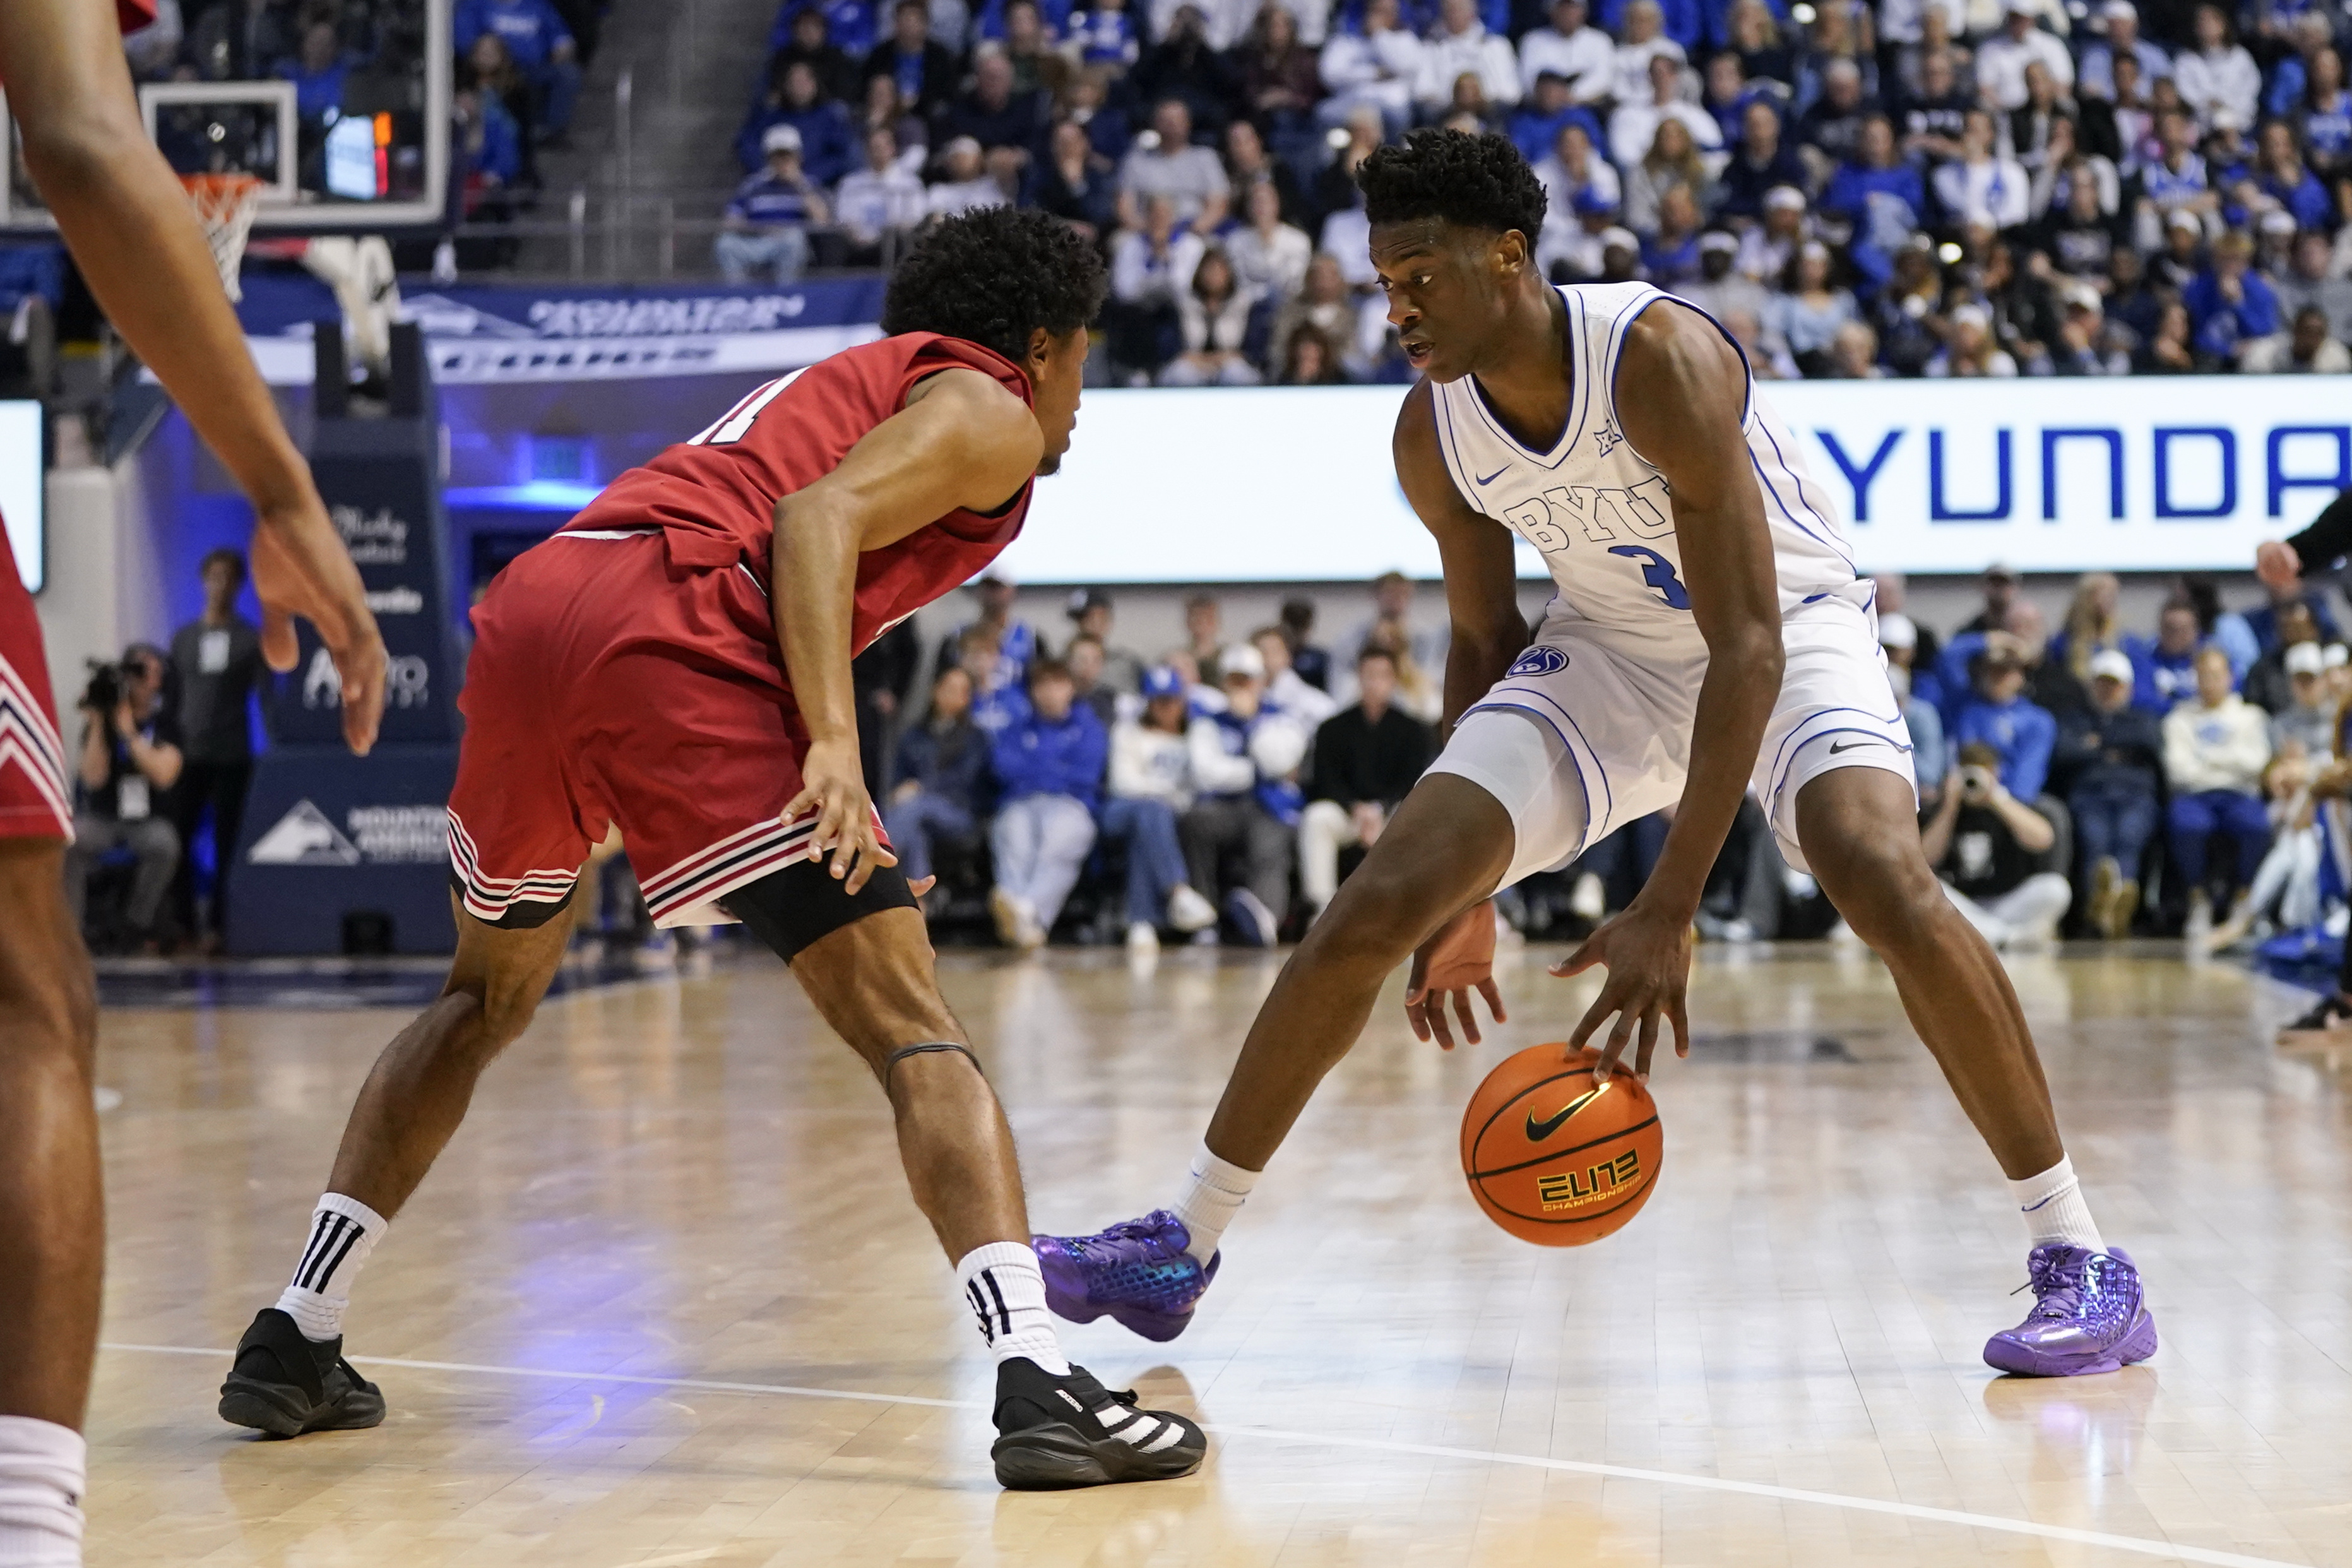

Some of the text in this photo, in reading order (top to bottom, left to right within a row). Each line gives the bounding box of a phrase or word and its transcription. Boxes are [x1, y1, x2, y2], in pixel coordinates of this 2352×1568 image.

[1813, 425, 2352, 523] YUNDA
[1503, 475, 1677, 554] BYU
[1607, 545, 1693, 610] 3
[1537, 1148, 1640, 1204] ELITE
[1543, 1175, 1641, 1211] CHAMPIONSHIP
